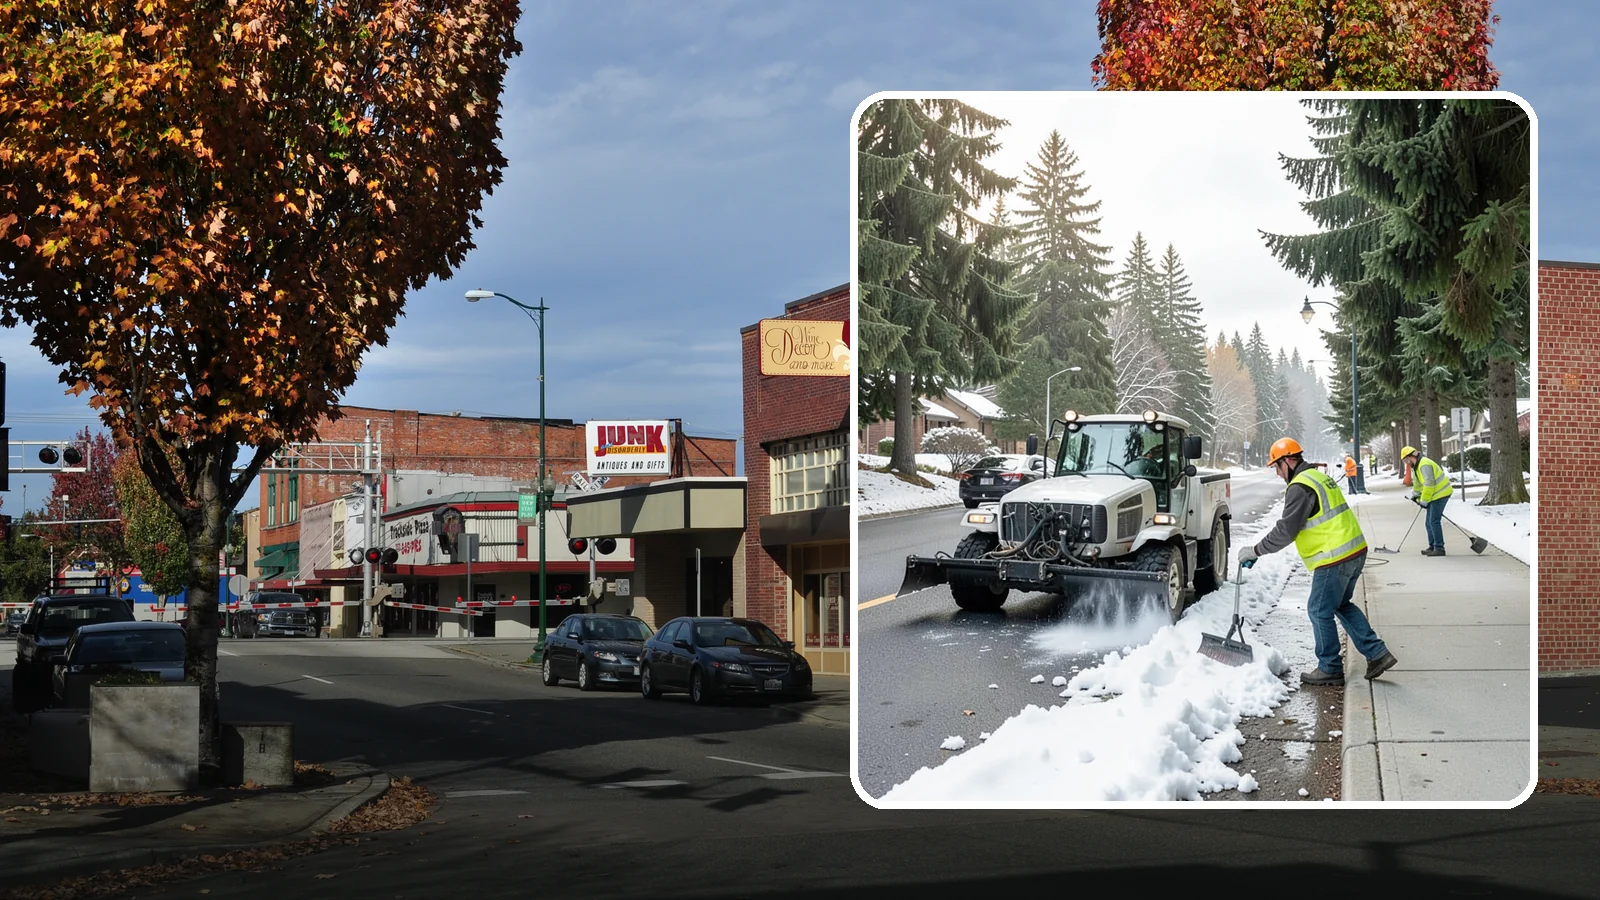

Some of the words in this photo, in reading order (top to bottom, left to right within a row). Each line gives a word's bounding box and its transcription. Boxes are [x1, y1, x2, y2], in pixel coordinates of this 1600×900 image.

[791, 325, 823, 344] Wine
[596, 425, 666, 457] JUNK
[608, 446, 646, 454] DISORDERLY
[597, 461, 628, 470] ANTIQUES
[631, 461, 644, 470] AND
[647, 460, 665, 470] GIFTS
[390, 521, 413, 539] Trackside
[414, 519, 429, 535] Pizza
